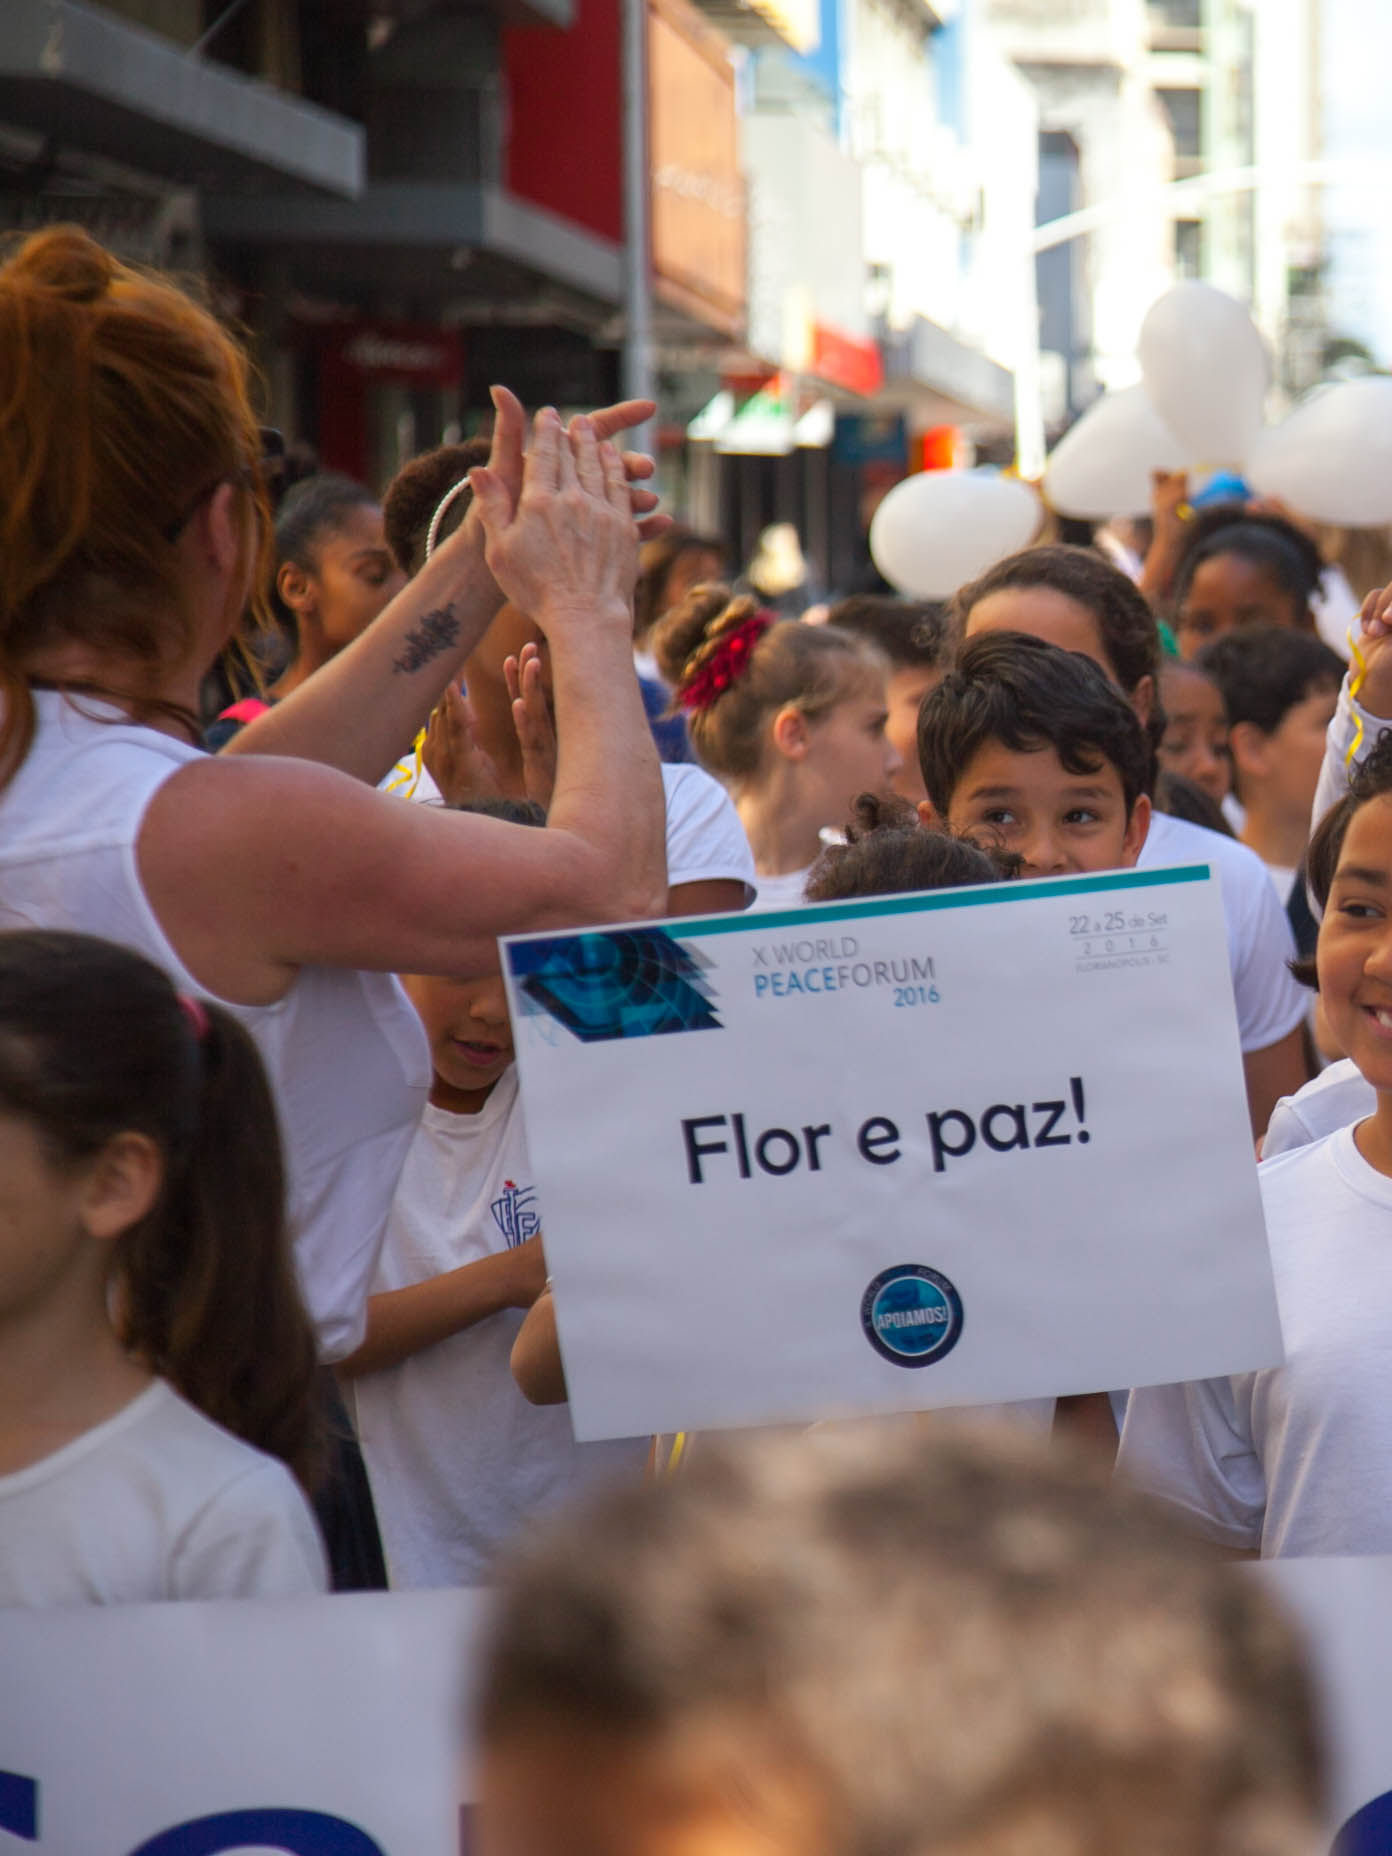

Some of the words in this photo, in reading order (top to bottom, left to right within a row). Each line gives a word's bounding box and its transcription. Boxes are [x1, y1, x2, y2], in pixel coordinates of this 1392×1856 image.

[1069, 914, 1089, 934] 22
[1104, 911, 1125, 931] 25
[752, 947, 768, 967] X
[773, 936, 859, 965] WORLD
[893, 985, 941, 1008] 2016
[681, 1112, 831, 1184] Flor
[857, 1116, 902, 1165] e
[925, 1076, 1090, 1173] paz!
[878, 1305, 948, 1330] APOIAMOS!
